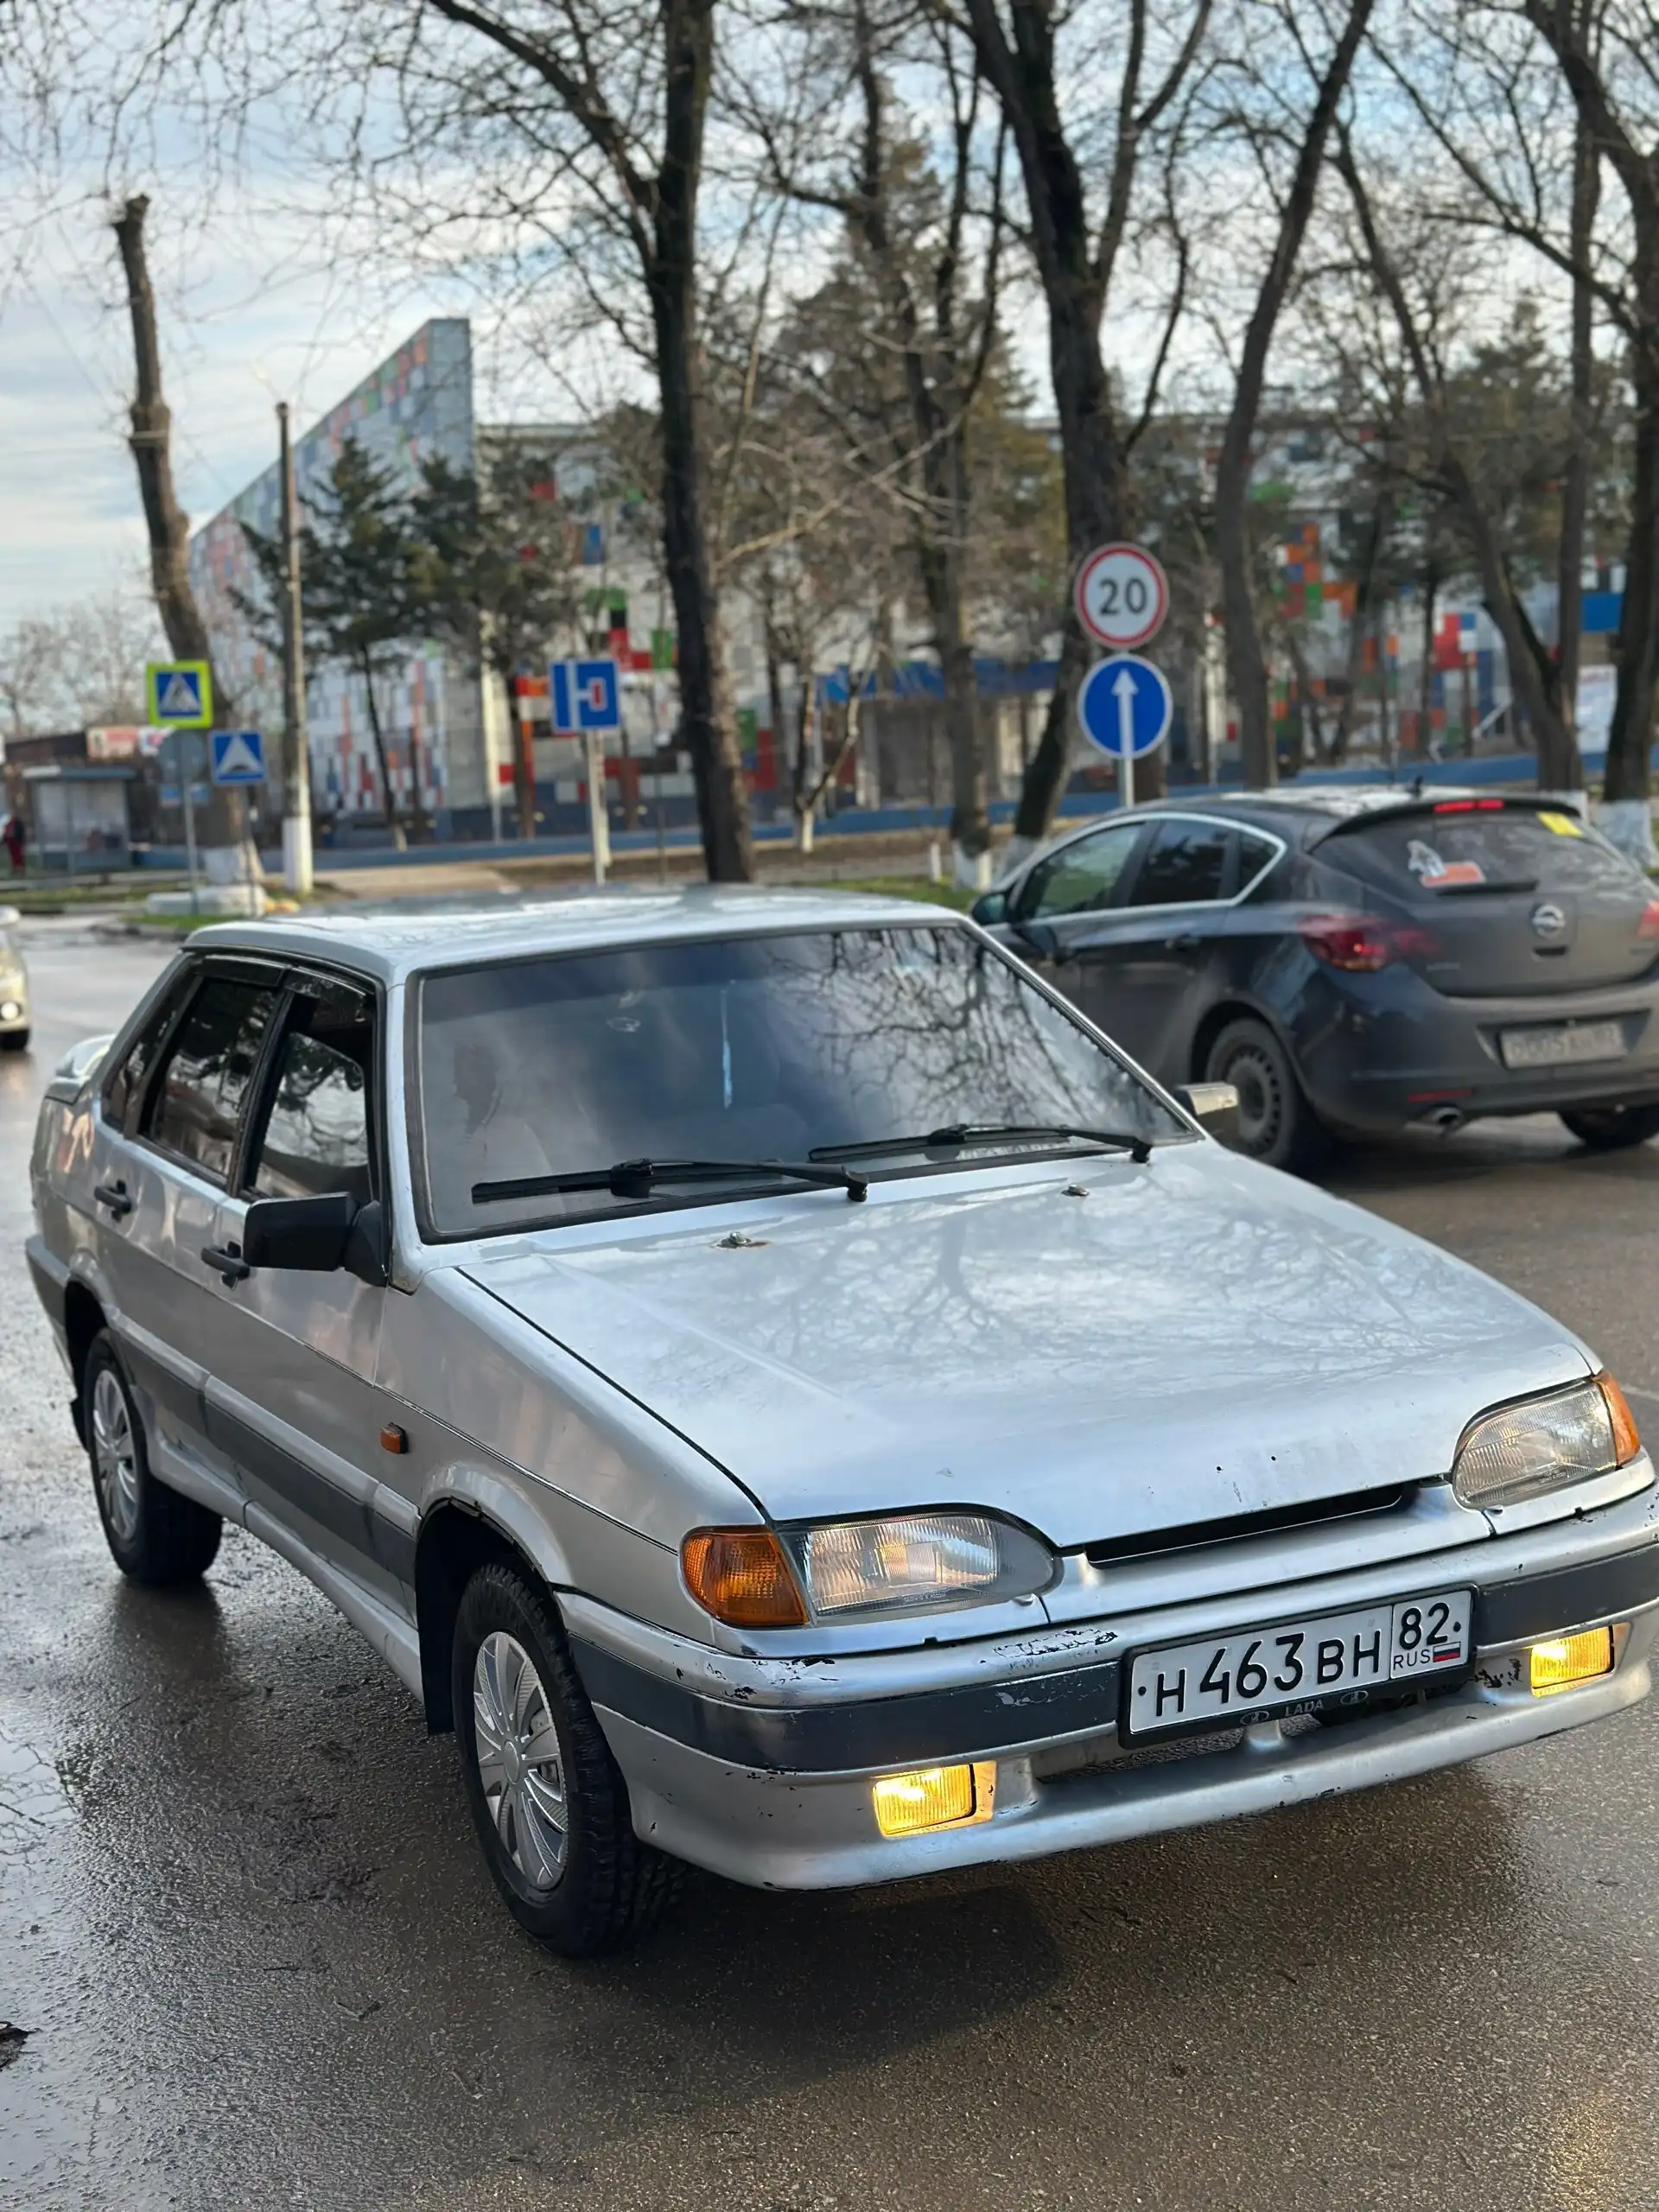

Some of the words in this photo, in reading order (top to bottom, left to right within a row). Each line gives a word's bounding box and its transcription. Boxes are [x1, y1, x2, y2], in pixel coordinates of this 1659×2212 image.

[1098, 578, 1147, 615] 20
[1400, 1602, 1449, 1649] 82
[1394, 1649, 1430, 1670] RUS
[1285, 1699, 1324, 1717] LADA
